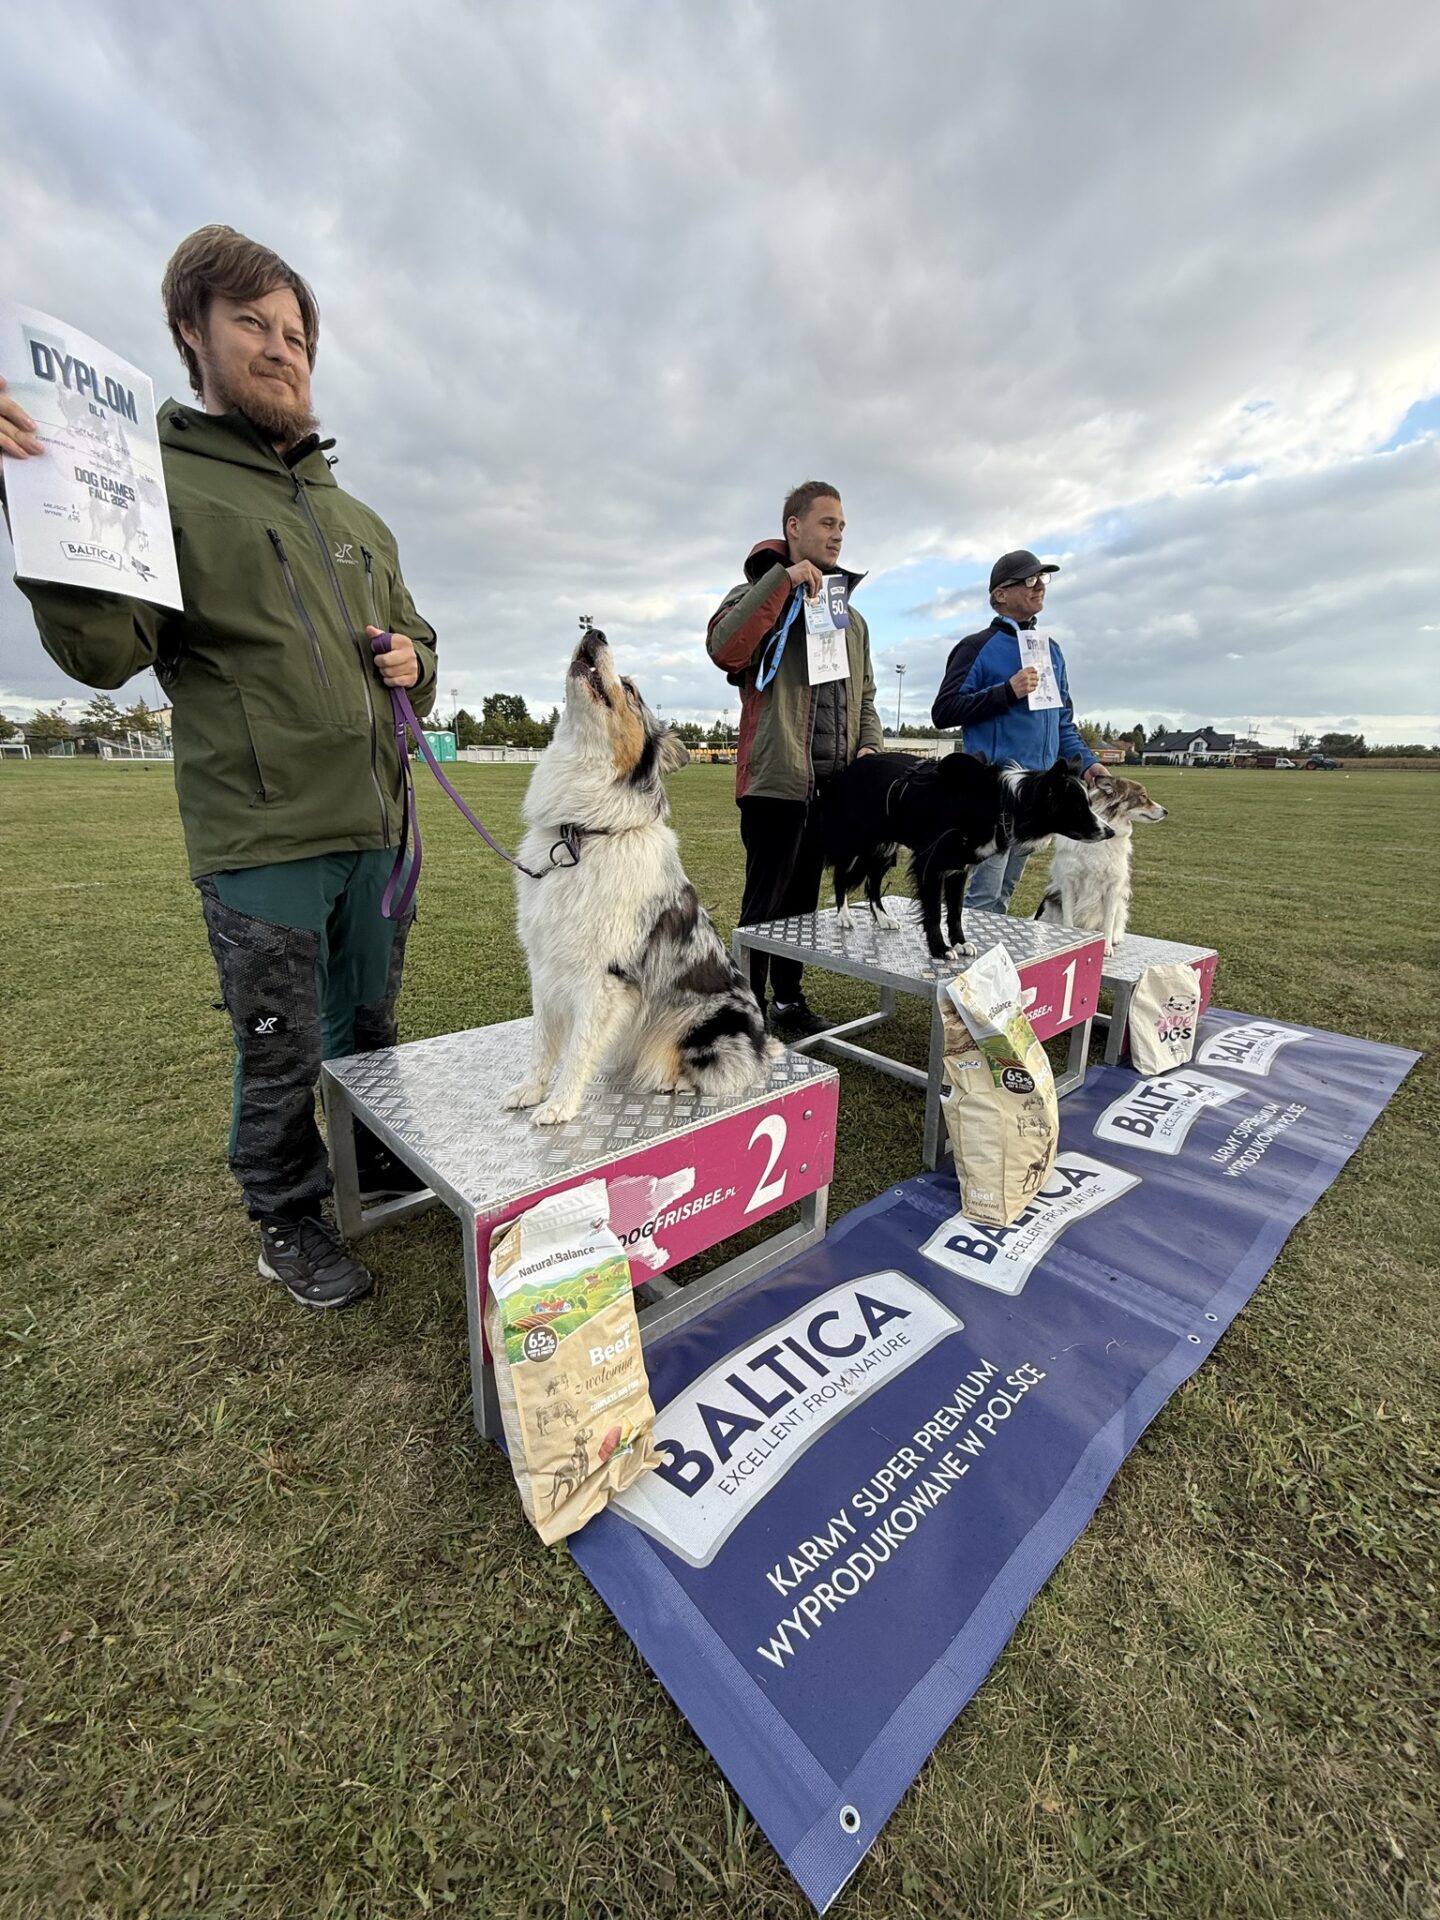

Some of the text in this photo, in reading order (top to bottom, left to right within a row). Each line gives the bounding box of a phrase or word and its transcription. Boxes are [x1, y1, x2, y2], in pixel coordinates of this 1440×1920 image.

[30, 339, 138, 425] DYPLOM
[88, 402, 106, 420] DLA
[74, 466, 100, 488] DOG
[101, 476, 135, 502] GAMES
[88, 486, 110, 503] FALL
[67, 544, 117, 563] BALTICA
[832, 600, 844, 615] 50
[1056, 958, 1077, 1025] 1
[743, 1113, 788, 1215] 2
[970, 1190, 995, 1201] Beef
[1005, 1221, 1047, 1261] EXCELLENT
[1067, 1184, 1106, 1211] NATURE
[528, 1331, 555, 1349] 65%
[588, 1331, 631, 1367] Beef
[653, 1292, 912, 1498] BALTICA
[717, 1332, 912, 1495] EXCELLENT FROM NATURE
[766, 1357, 999, 1597] KARMY SUPER PREMIUM
[757, 1362, 1046, 1668] WYPRODUKOWANE W POLSCE
